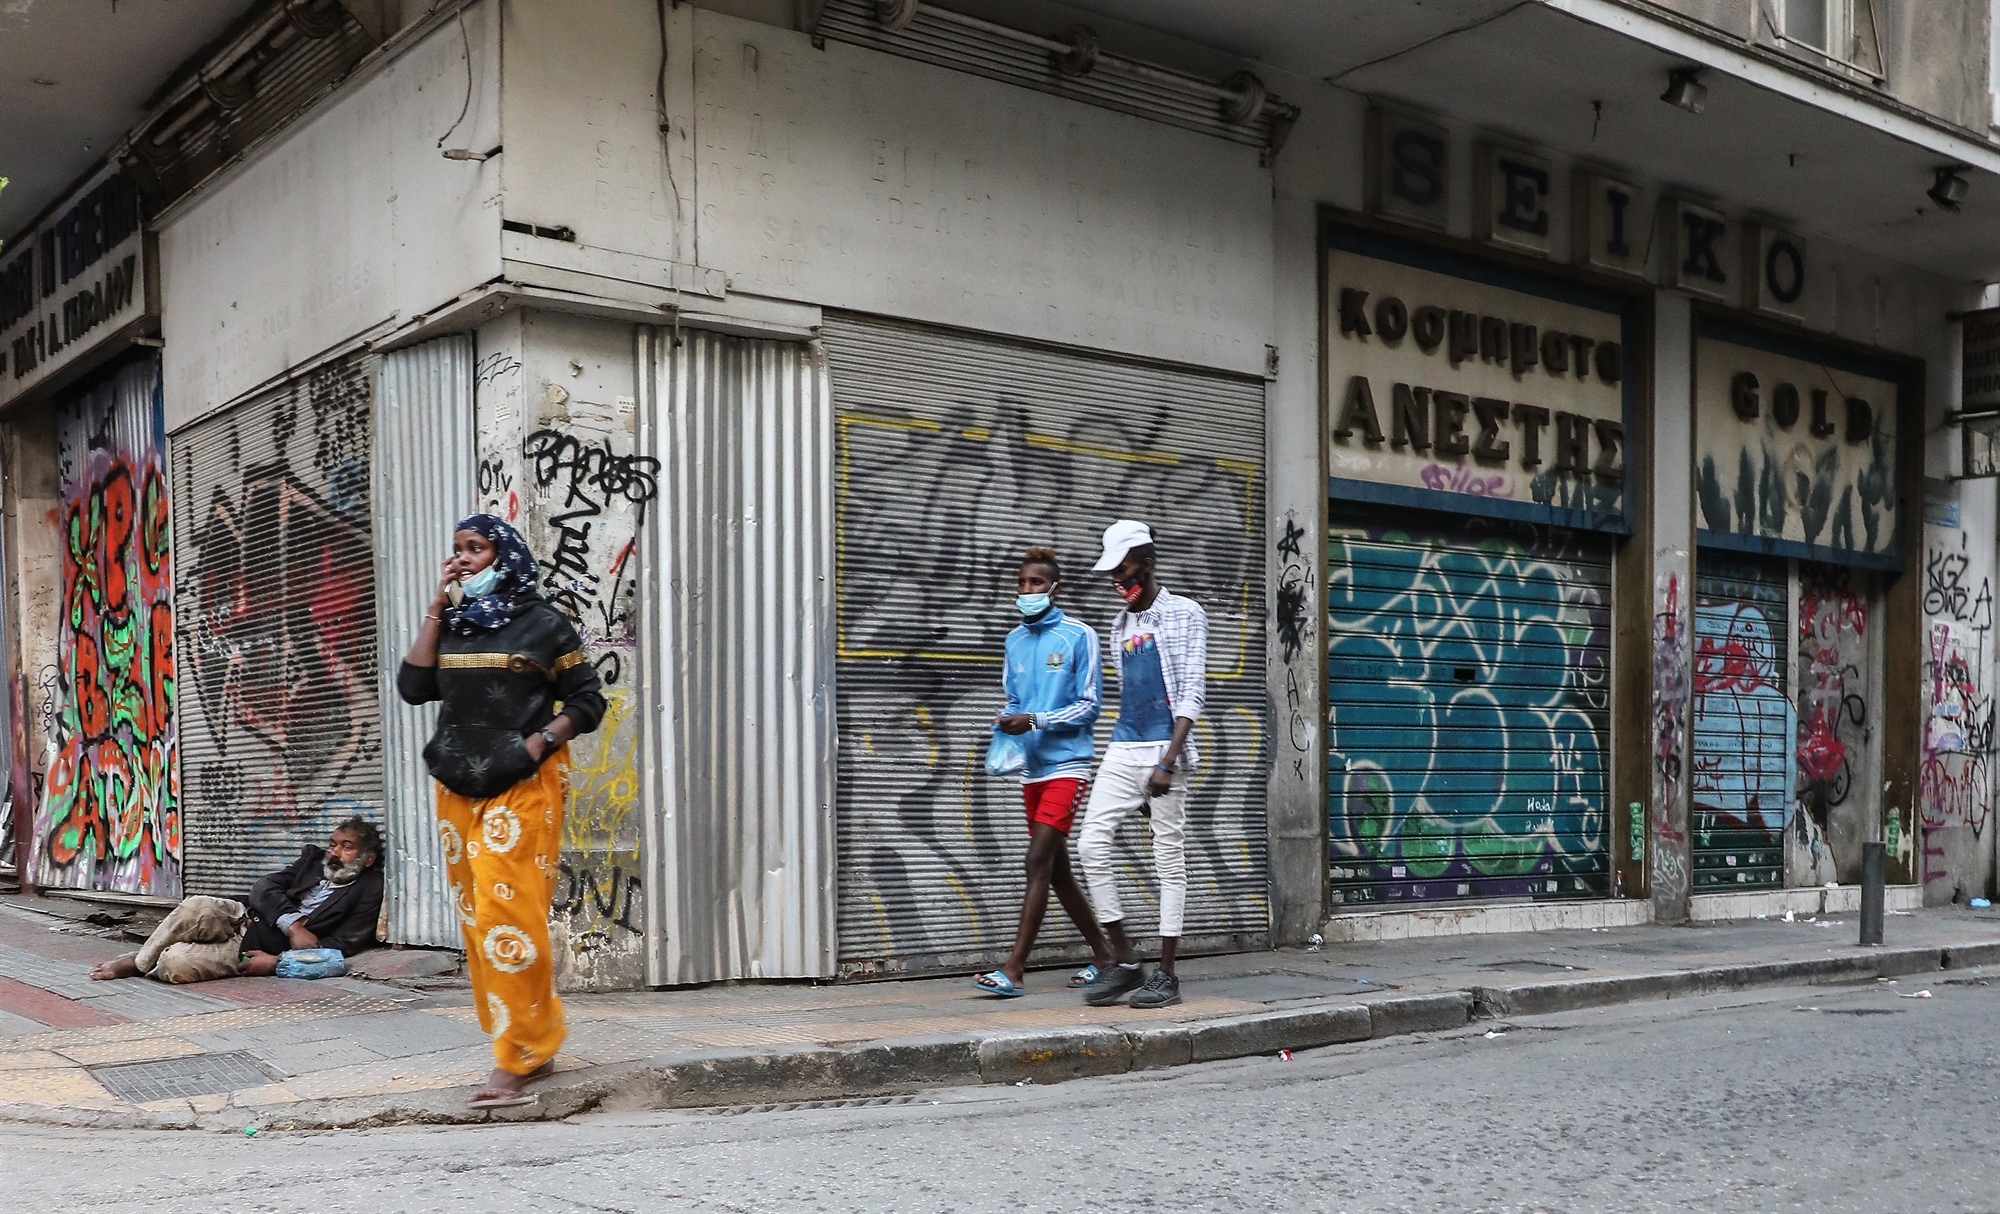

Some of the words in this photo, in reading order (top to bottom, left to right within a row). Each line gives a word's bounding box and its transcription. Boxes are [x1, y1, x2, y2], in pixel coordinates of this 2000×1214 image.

[1393, 129, 1802, 302] SEIKO
[1333, 375, 1625, 481] ΑΝΕΣΤΗΣ
[1731, 370, 1873, 442] GOLD
